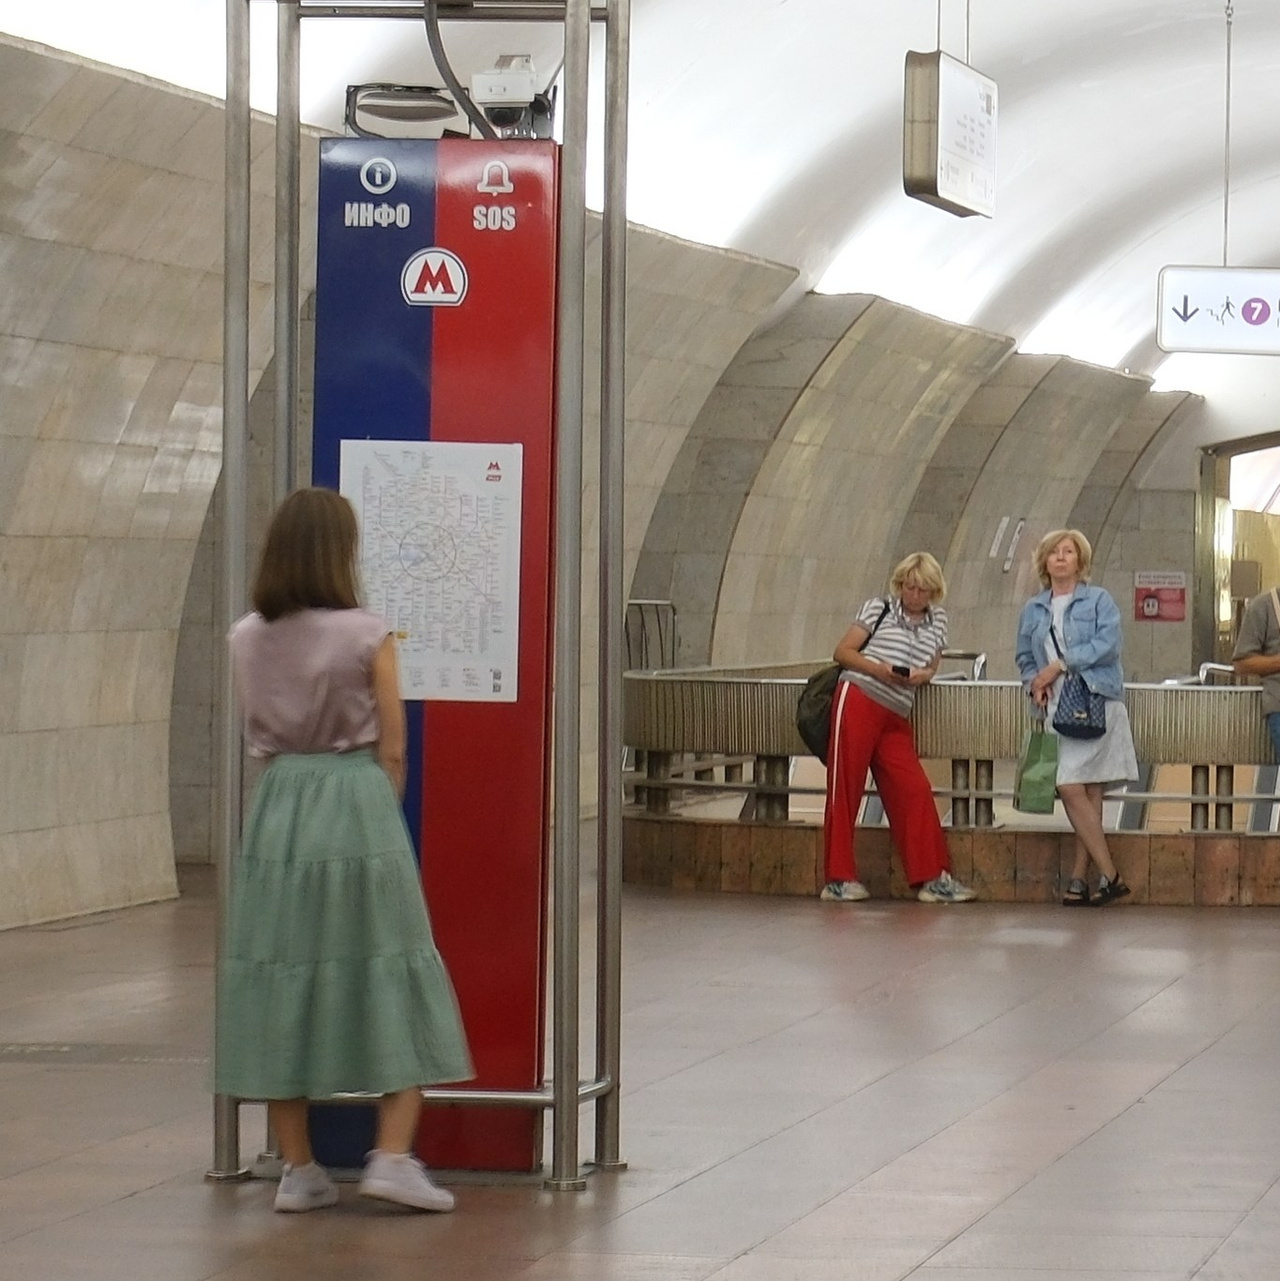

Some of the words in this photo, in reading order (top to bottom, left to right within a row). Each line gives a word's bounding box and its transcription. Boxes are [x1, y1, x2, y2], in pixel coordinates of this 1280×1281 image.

[344, 202, 411, 228] ИНФО
[473, 205, 516, 231] SOS
[1250, 302, 1263, 320] 7
